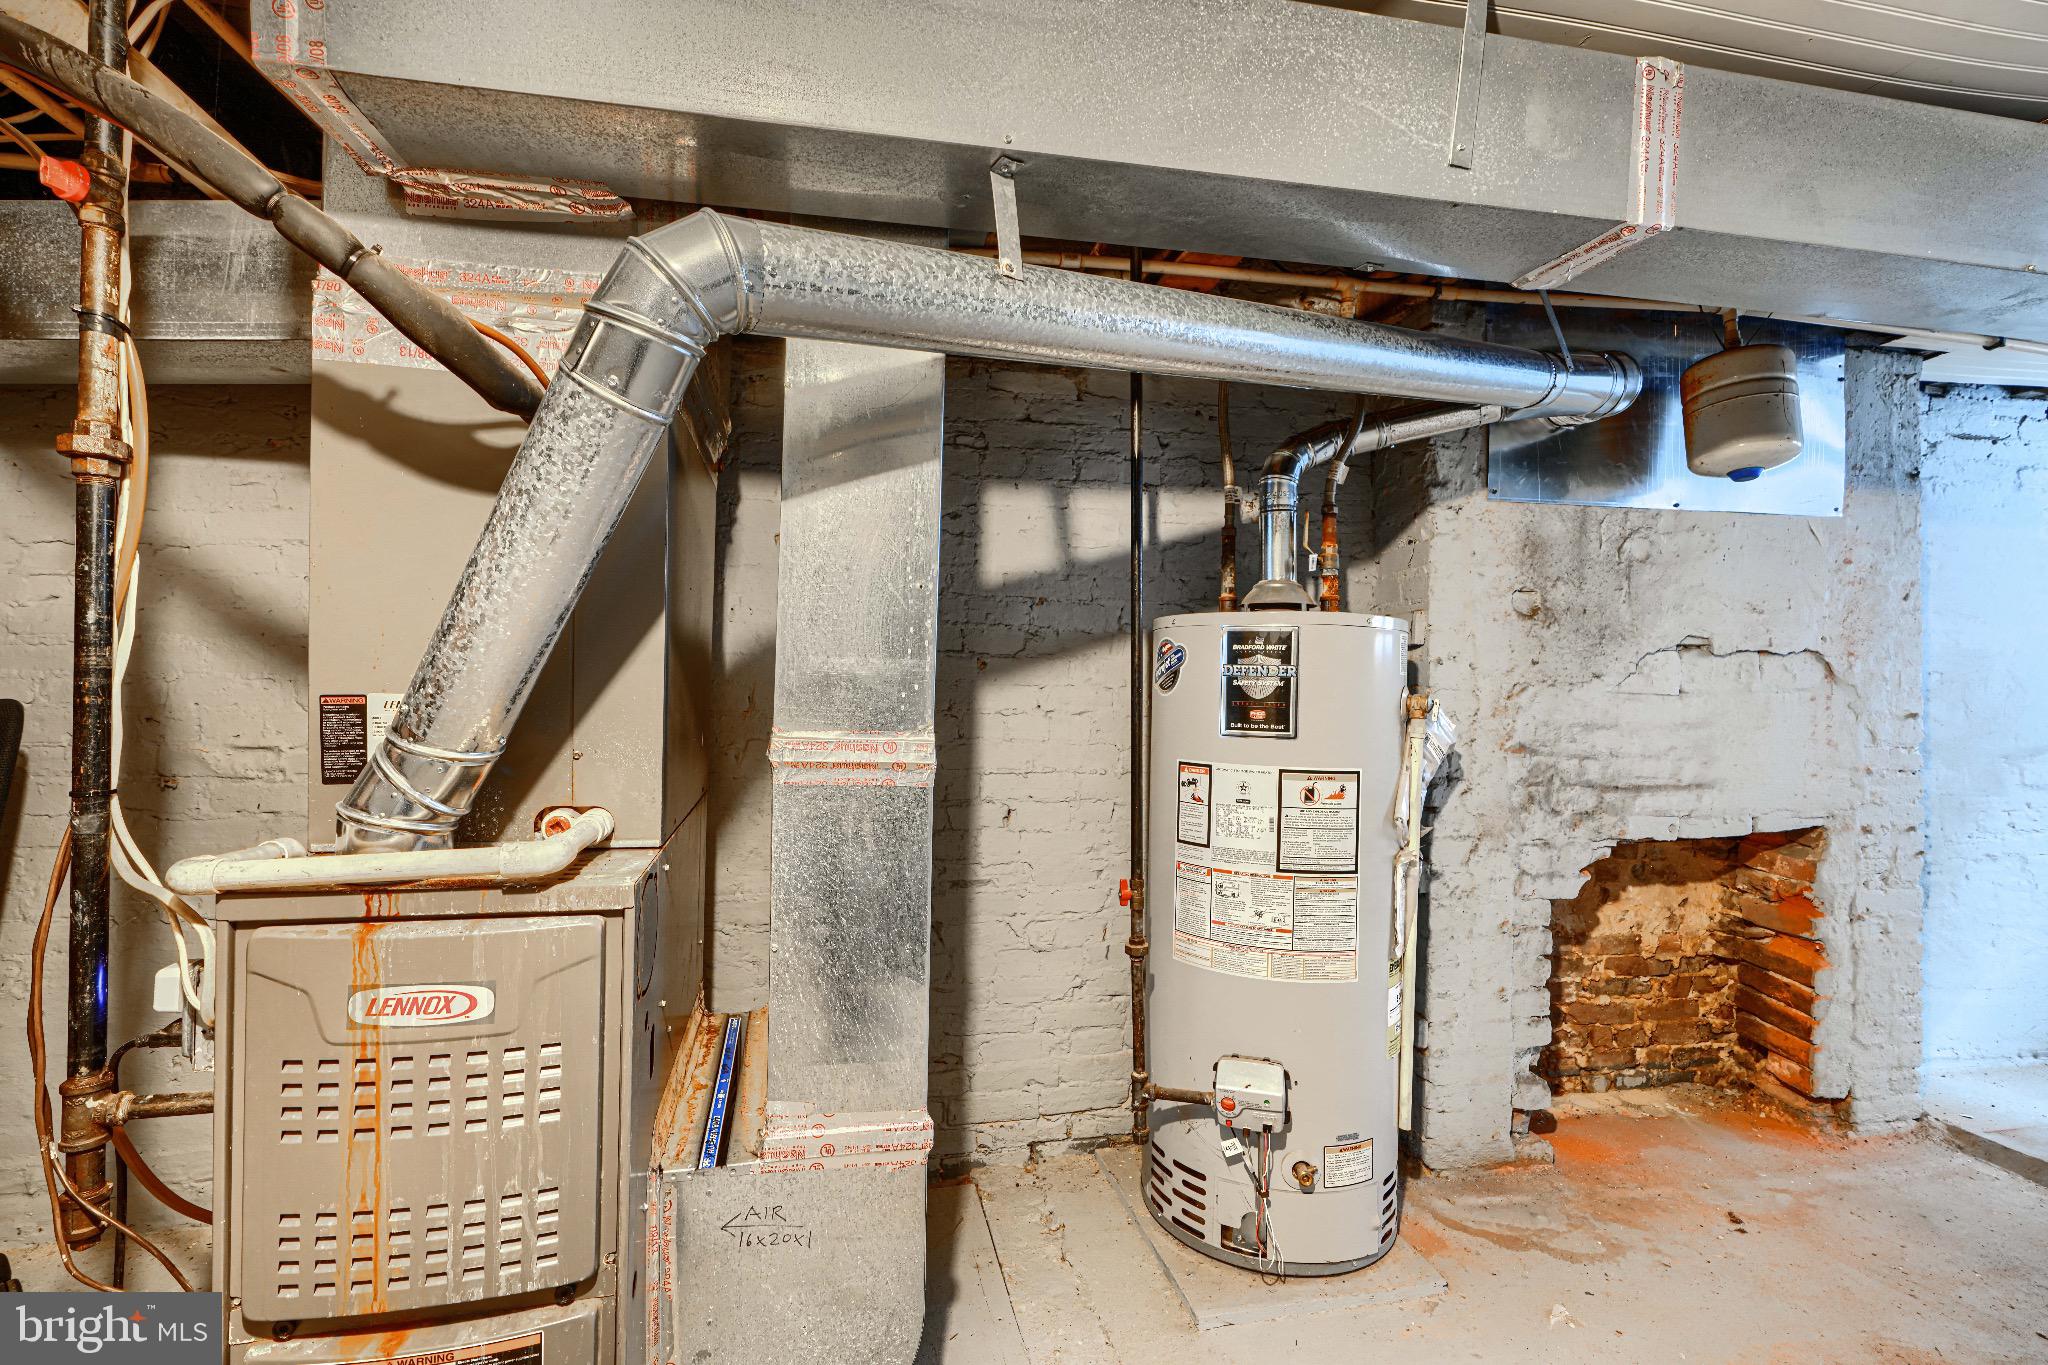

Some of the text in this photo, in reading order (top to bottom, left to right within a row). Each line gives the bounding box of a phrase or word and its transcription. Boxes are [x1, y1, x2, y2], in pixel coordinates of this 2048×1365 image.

[463, 198, 495, 209] 324A
[459, 272, 491, 285] 324A
[1222, 664, 1297, 677] DEFENDER
[365, 995, 456, 1017] LENNOX
[745, 1205, 787, 1222] AIR
